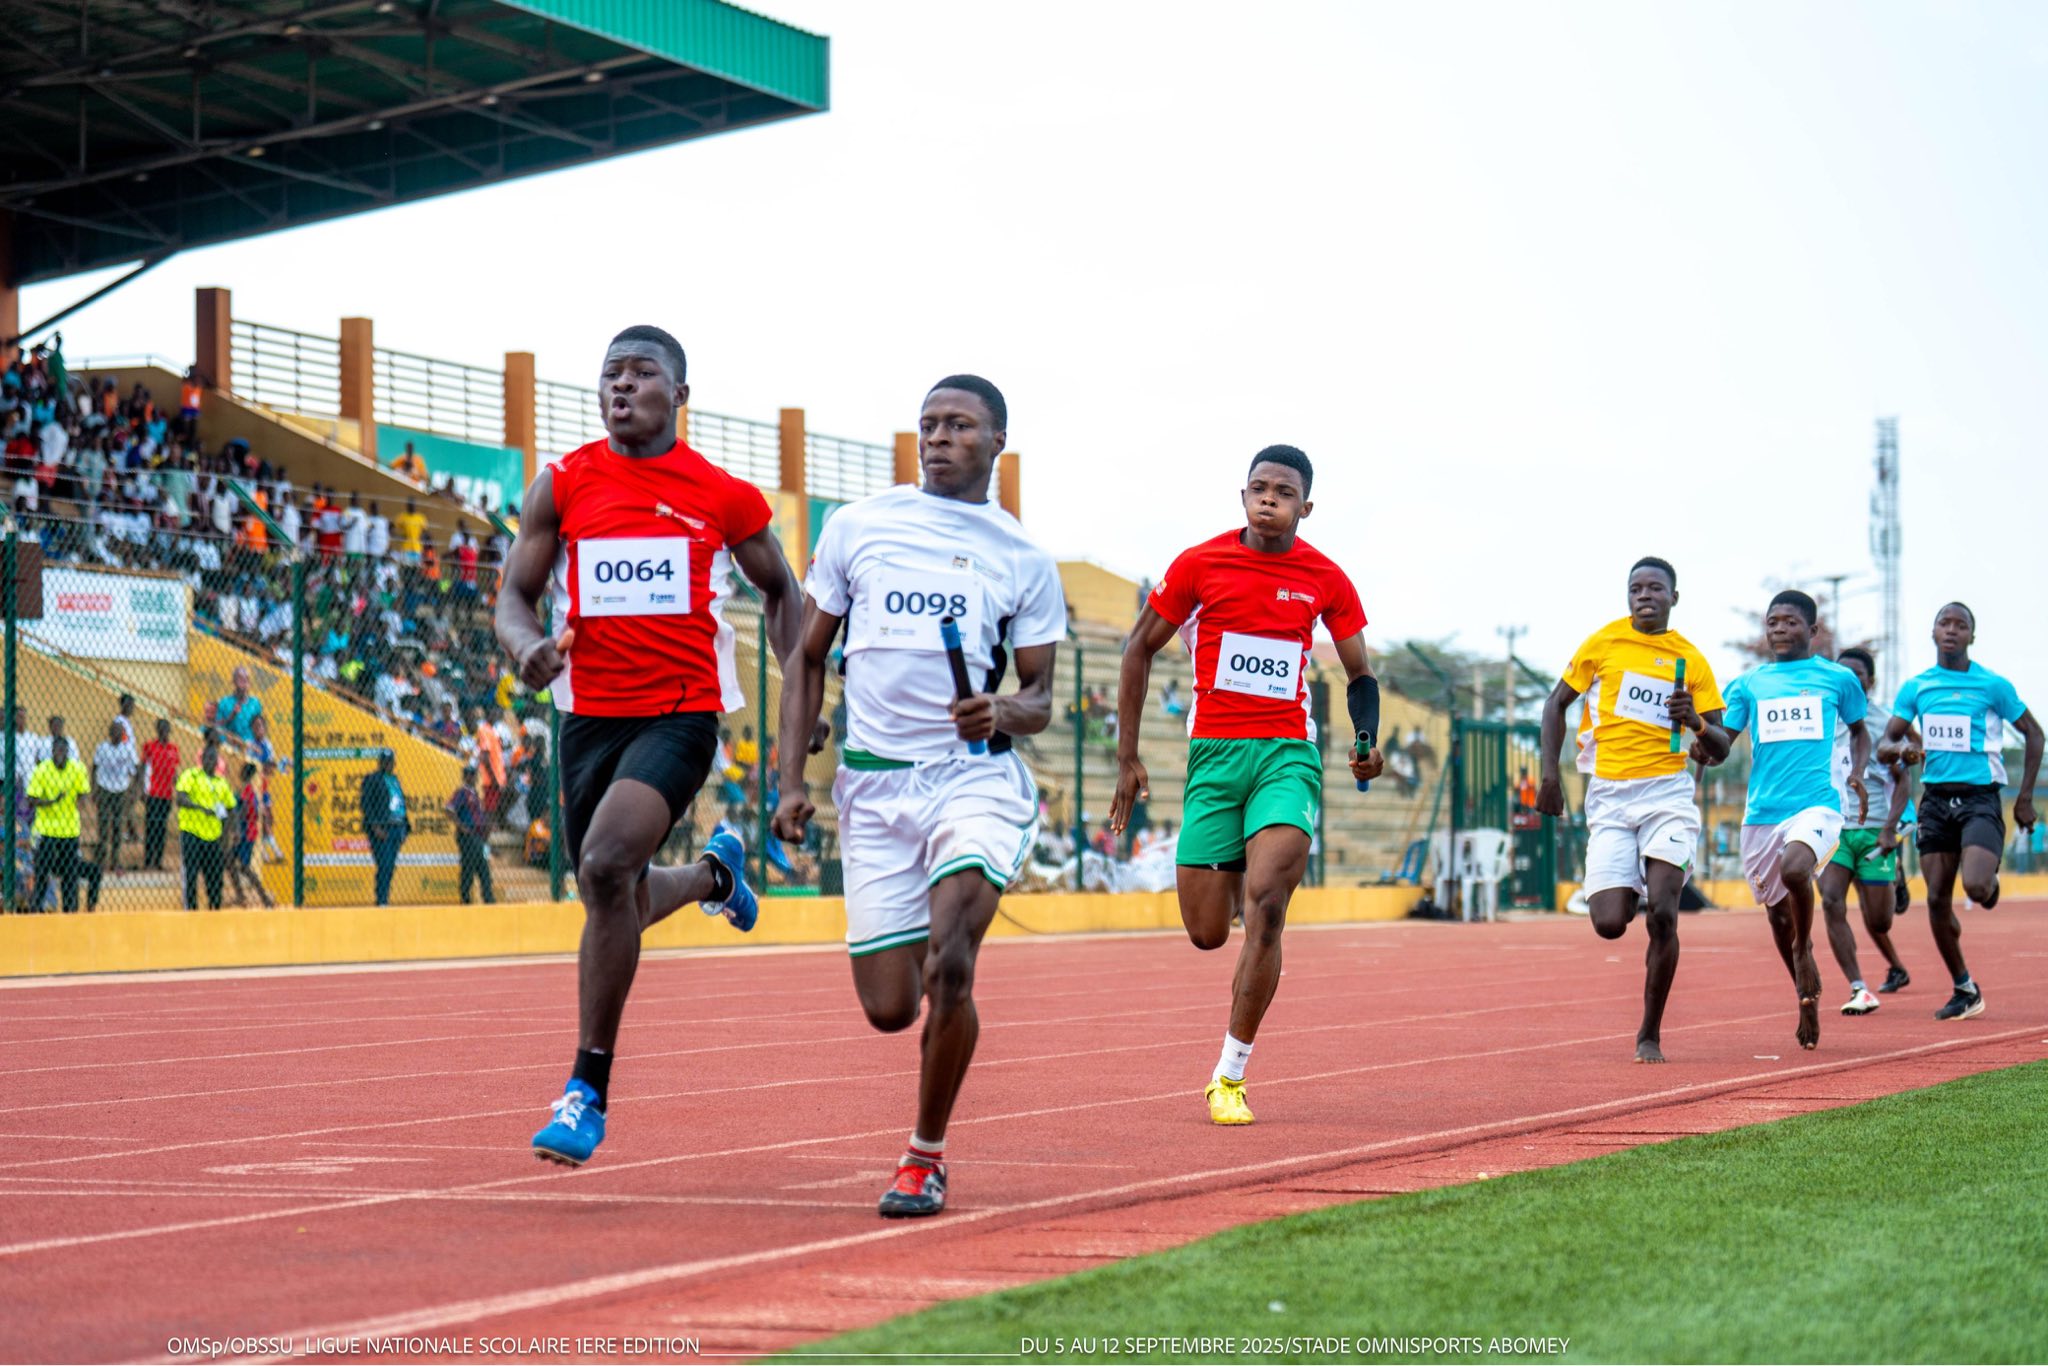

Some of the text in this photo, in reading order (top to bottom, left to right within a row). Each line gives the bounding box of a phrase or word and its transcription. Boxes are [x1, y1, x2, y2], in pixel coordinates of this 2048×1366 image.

[594, 559, 675, 583] 0064
[885, 591, 967, 617] 0098
[1229, 653, 1290, 678] 0083
[1766, 706, 1813, 723] 0181
[1928, 725, 1964, 739] 0118
